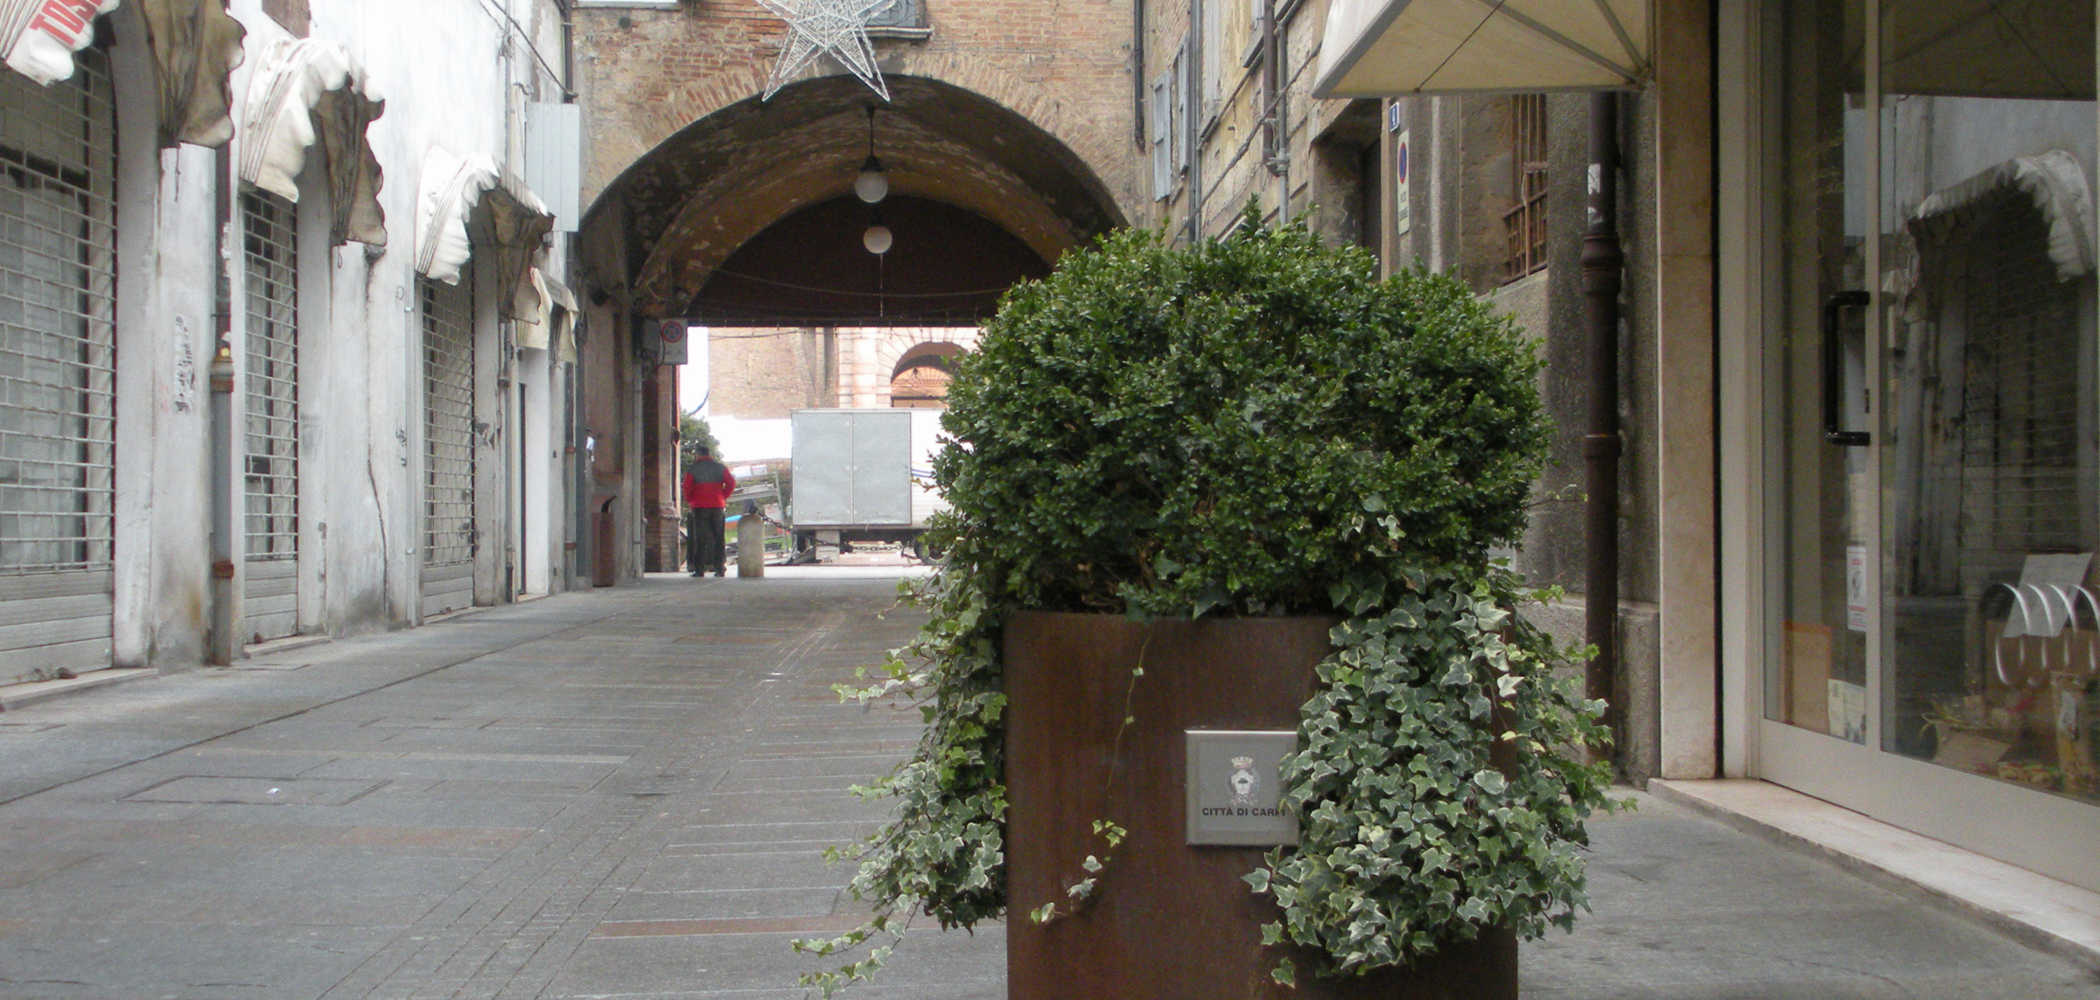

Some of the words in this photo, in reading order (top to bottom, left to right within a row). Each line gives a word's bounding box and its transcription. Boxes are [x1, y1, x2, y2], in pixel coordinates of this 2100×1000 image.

[29, 0, 102, 46] TOS
[1202, 805, 1233, 817] CITTÀ
[1237, 807, 1248, 817] DI
